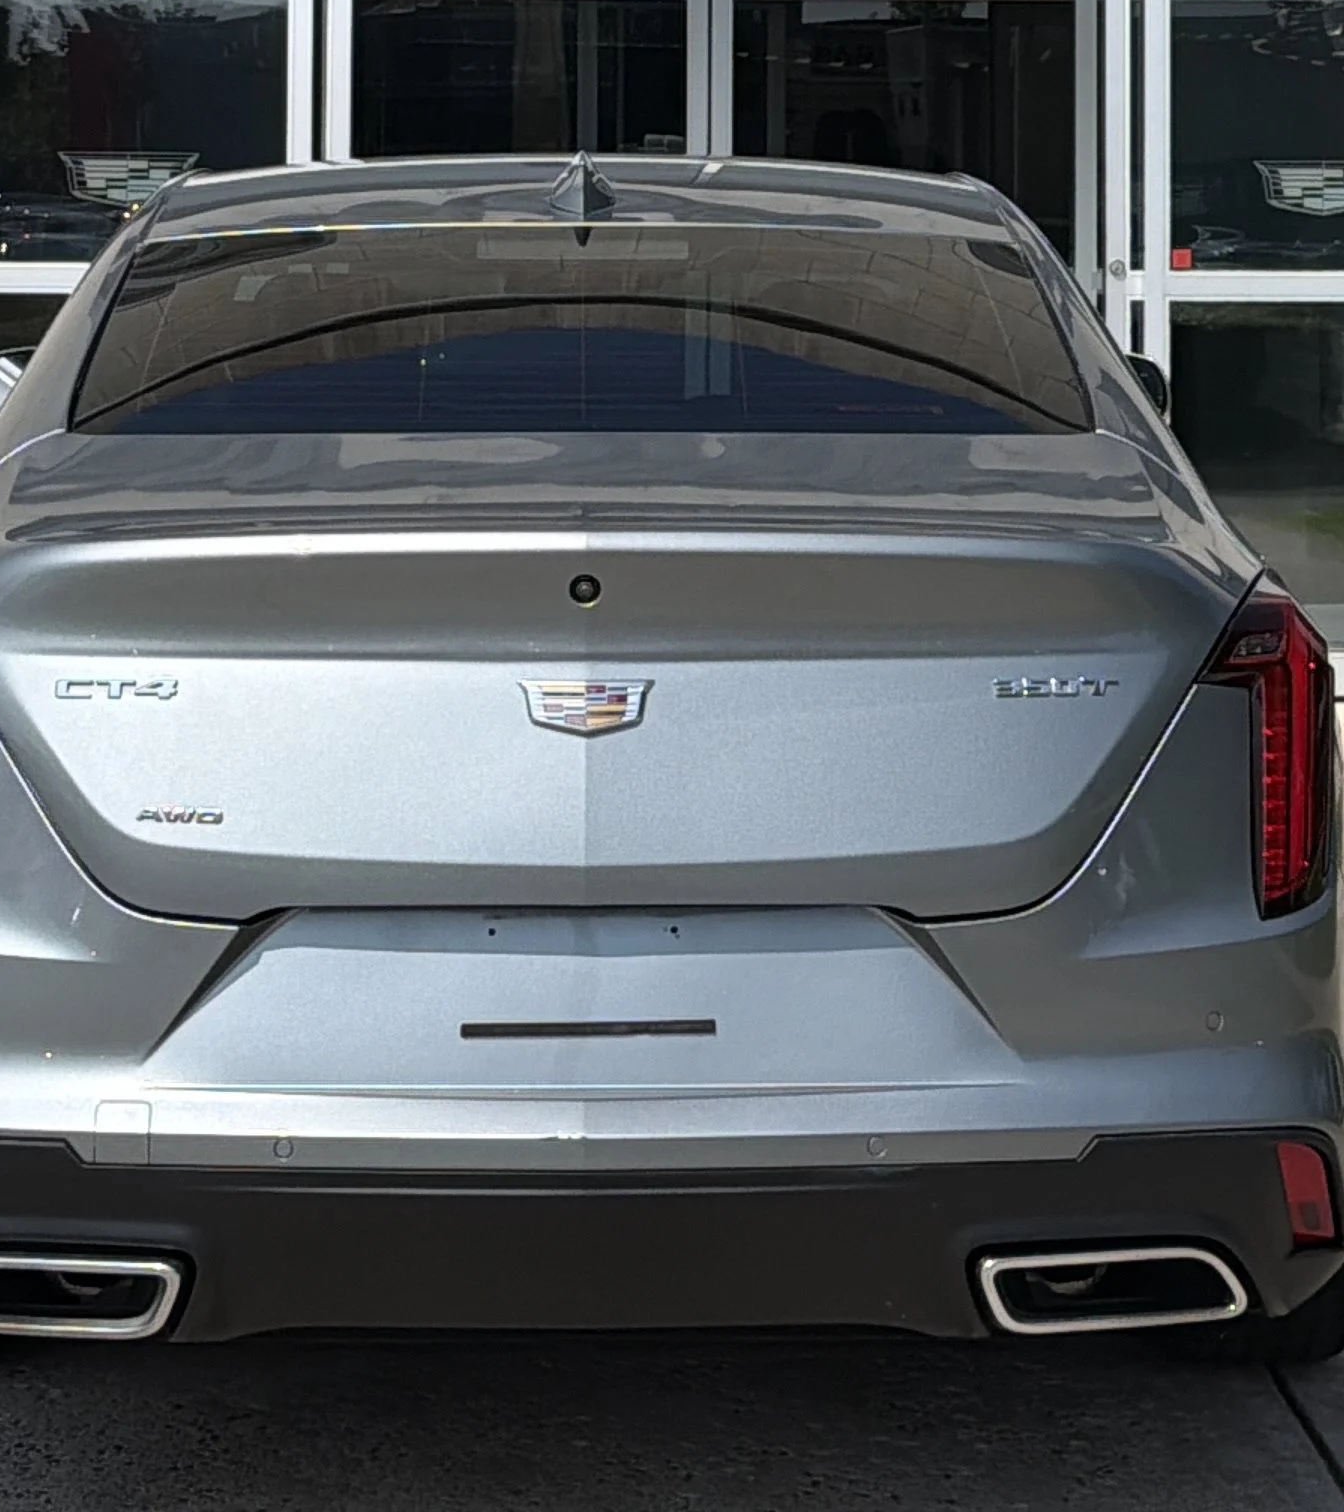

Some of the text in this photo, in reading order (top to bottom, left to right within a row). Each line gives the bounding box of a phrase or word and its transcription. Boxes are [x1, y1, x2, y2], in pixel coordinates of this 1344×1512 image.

[54, 678, 179, 701] CT4
[991, 676, 1120, 699] 350T
[135, 806, 224, 825] AWD
